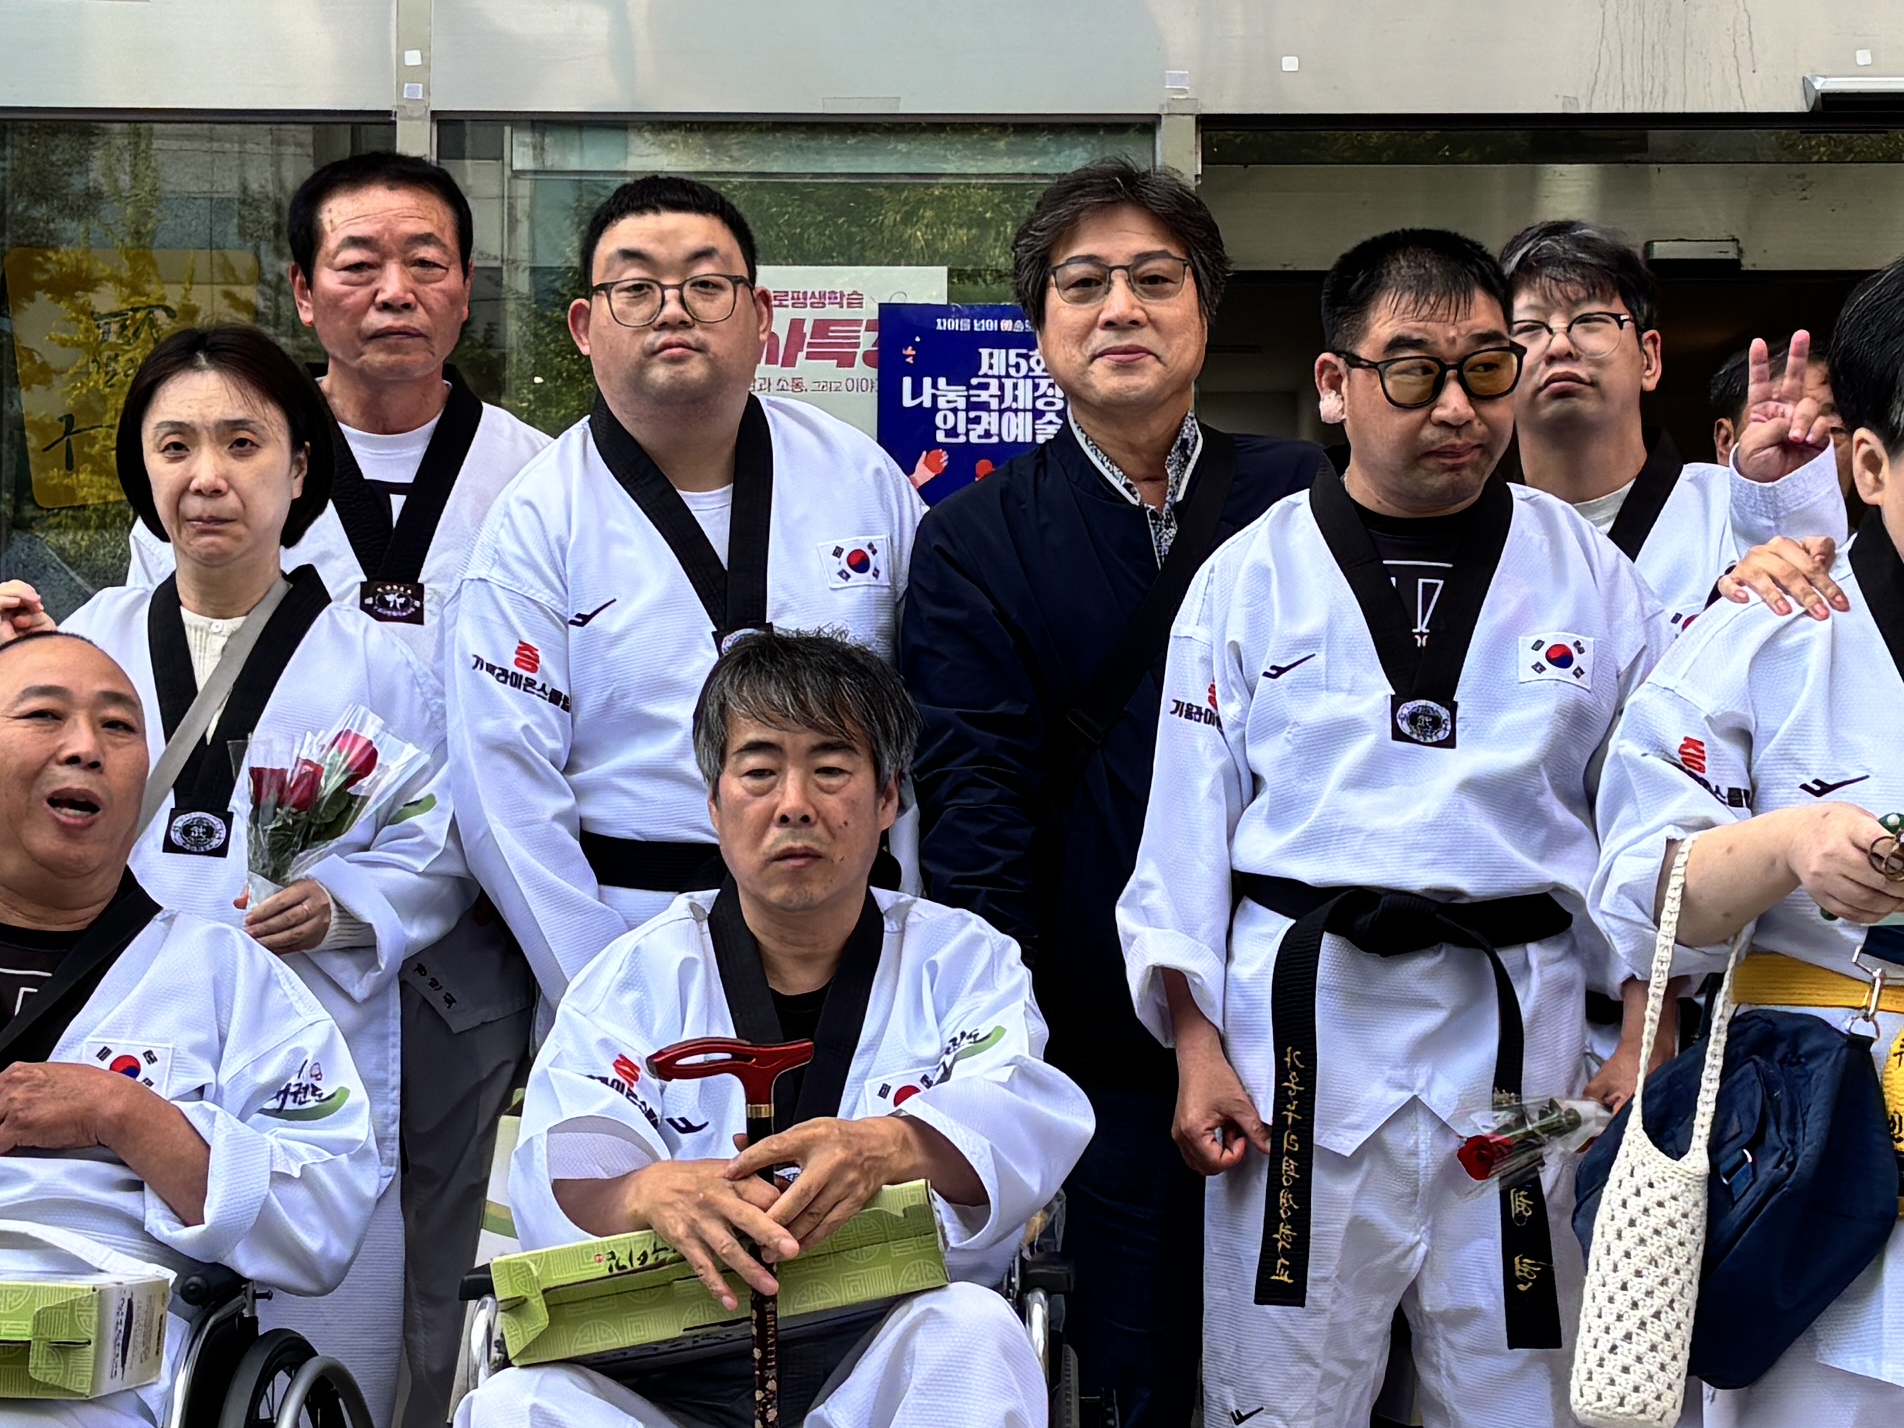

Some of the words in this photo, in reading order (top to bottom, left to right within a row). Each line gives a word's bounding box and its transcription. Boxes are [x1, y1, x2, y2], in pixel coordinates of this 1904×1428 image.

[772, 289, 865, 309] 로평생학습
[935, 317, 971, 332] 차이를
[973, 318, 999, 332] 넘어
[901, 376, 1066, 411] 나눔국제장
[935, 409, 1064, 444] 인권예술
